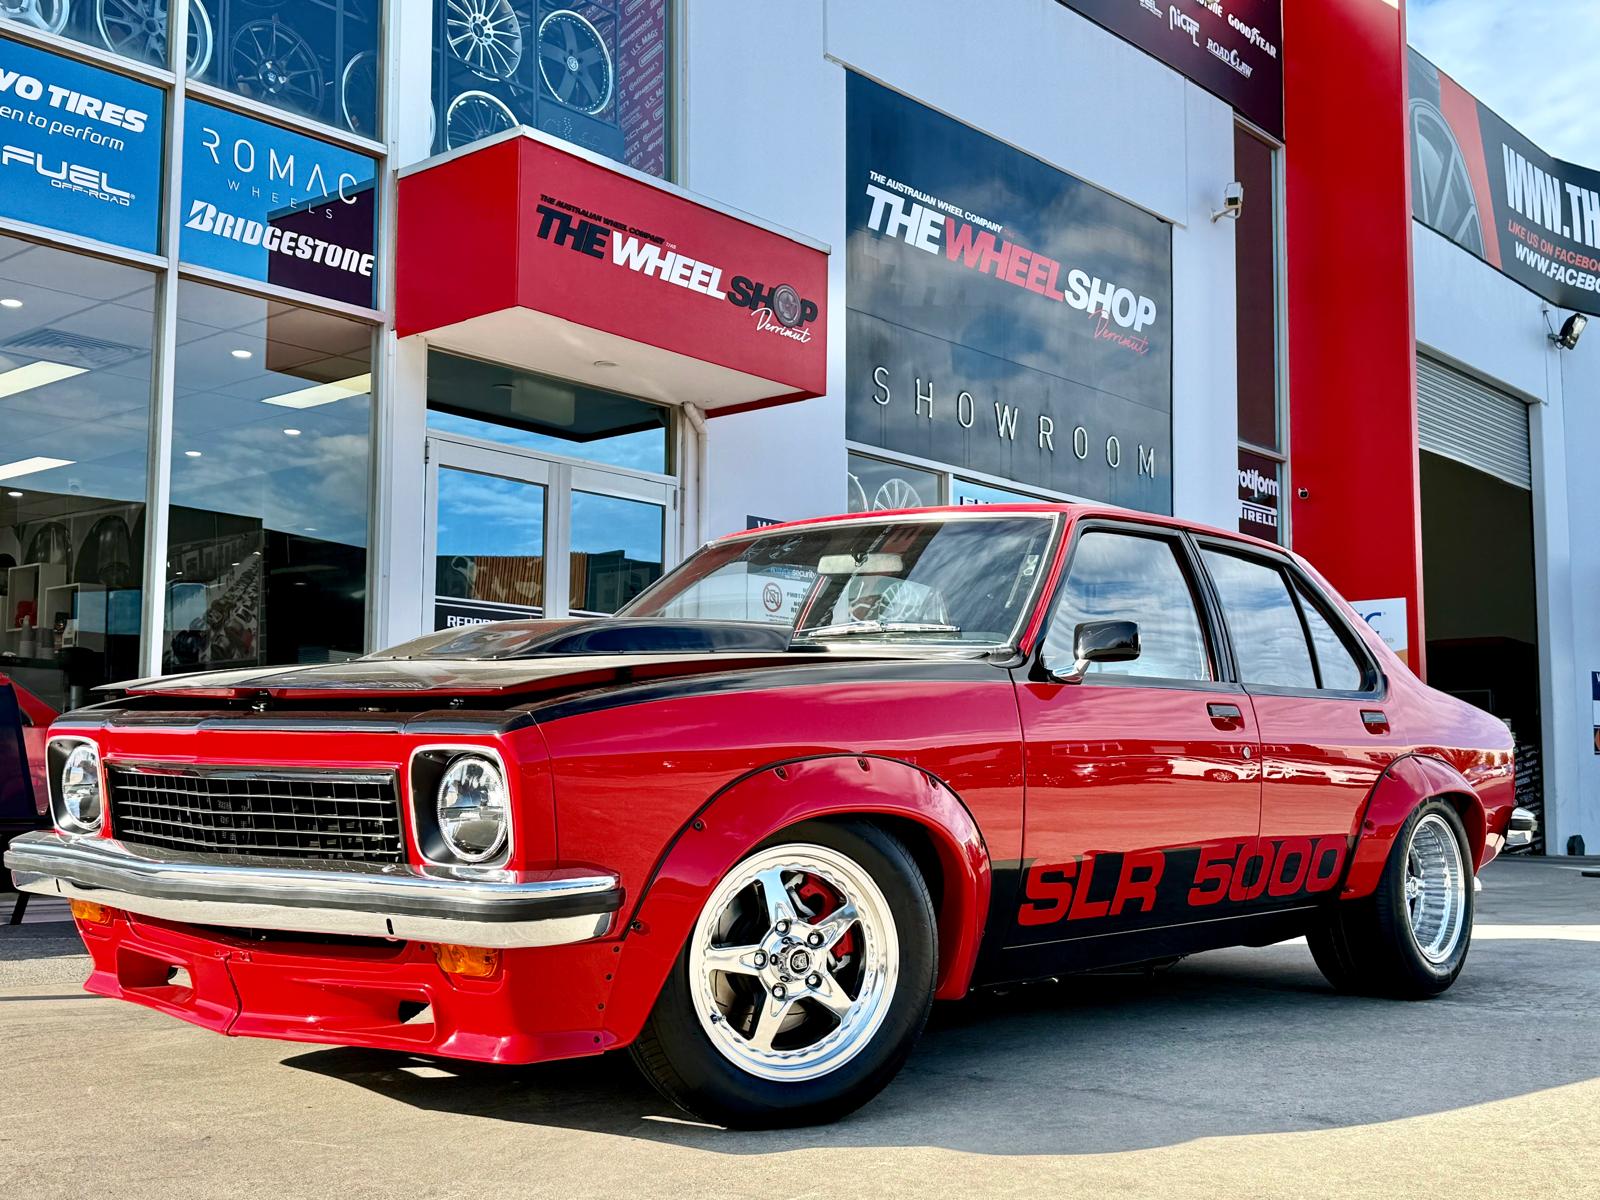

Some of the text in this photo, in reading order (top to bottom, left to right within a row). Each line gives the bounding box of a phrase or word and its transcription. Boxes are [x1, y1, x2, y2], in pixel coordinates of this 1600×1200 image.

[1227, 13, 1277, 59] GOODYEAR
[27, 111, 48, 129] to
[48, 120, 125, 151] perform
[48, 84, 149, 133] TIRES
[2, 145, 131, 199] FUEL
[50, 179, 131, 207] OFF-ROAD
[202, 127, 358, 205] ROMAC
[227, 178, 334, 220] WHEELS
[540, 193, 556, 205] THE
[555, 200, 602, 223] AUSTRALIAN
[603, 216, 628, 232] WHEEL
[628, 227, 666, 245] COMPANY
[869, 170, 887, 185] THE
[886, 178, 937, 207] AUSTRALIAN
[937, 199, 964, 219] WHEEL
[964, 211, 1003, 234] COMPANY
[184, 199, 376, 278] BRIDGESTONE
[536, 203, 611, 260] THE
[612, 230, 727, 300] WHEEL
[865, 183, 1157, 333] THE WHEEL SHOP
[1508, 219, 1600, 273] LIKE US ON FACEBO
[750, 307, 812, 343] Derrimut
[872, 365, 1156, 480] SHOWROOM
[1018, 836, 1349, 927] SLR 5000
